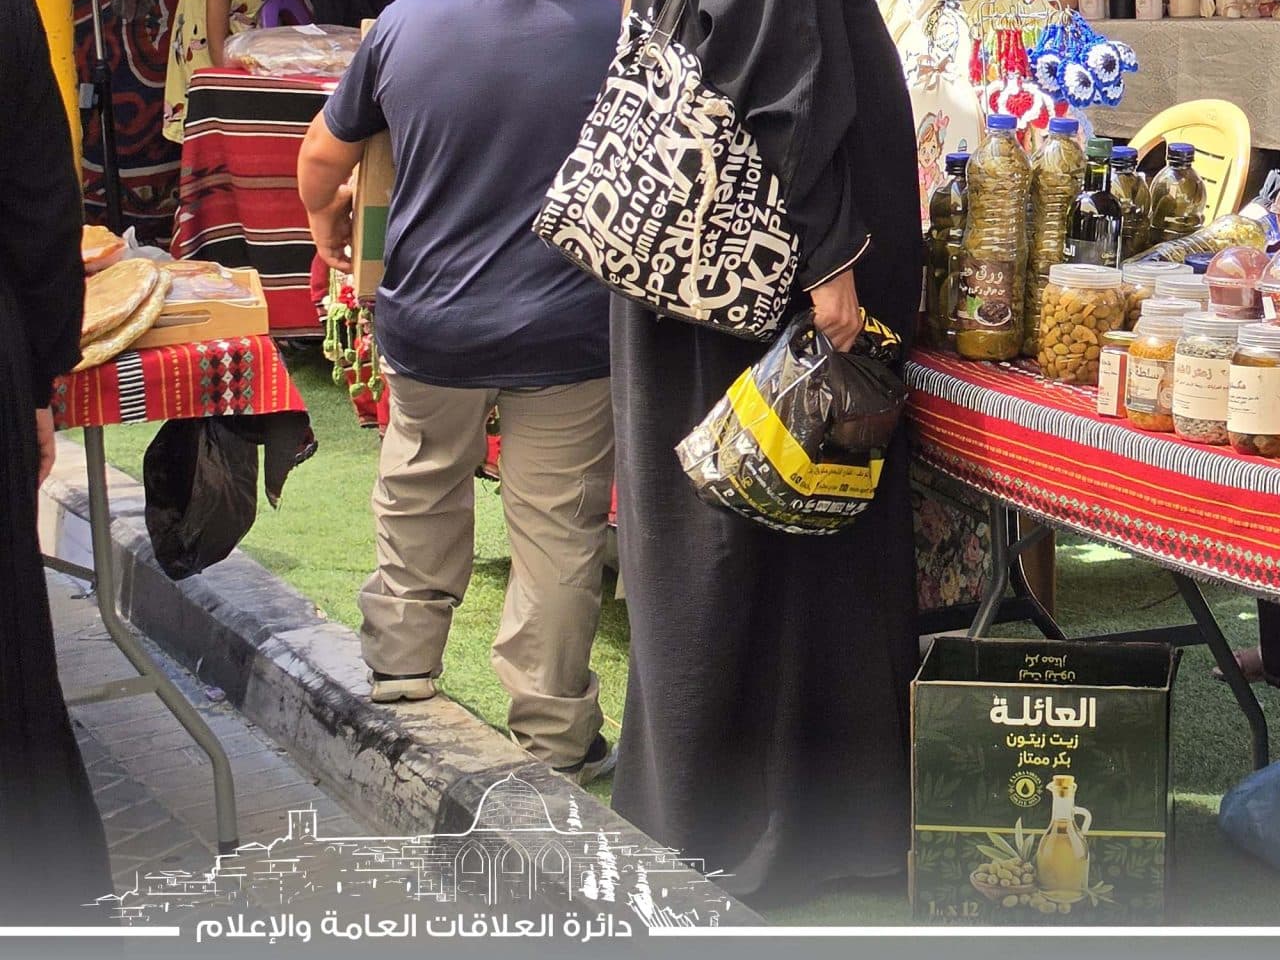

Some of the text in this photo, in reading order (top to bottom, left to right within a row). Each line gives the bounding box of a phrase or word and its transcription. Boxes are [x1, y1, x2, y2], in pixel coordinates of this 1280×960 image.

[990, 696, 1096, 727] العائلة
[1006, 733, 1079, 749] زيت زيتون
[1018, 751, 1071, 768] بكر ممتاز
